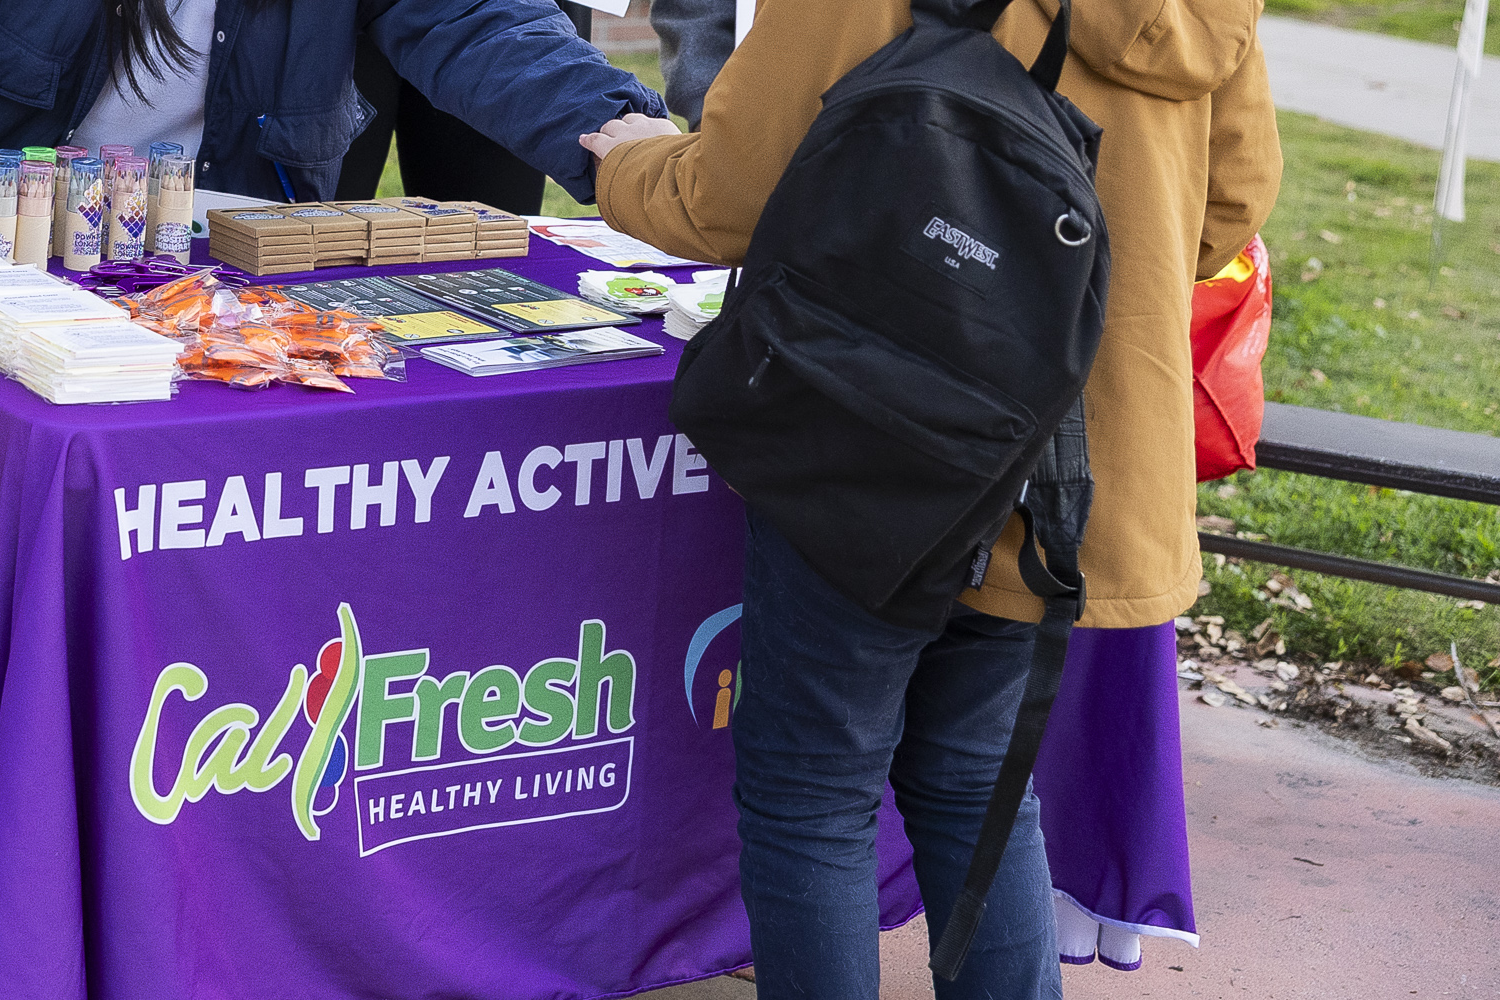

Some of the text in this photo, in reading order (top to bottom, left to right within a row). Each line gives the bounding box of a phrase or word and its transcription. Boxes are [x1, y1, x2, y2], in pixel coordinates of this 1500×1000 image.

[113, 433, 710, 561] HEALTHY ACTIVE
[368, 762, 618, 825] HEALTHY LIVING
